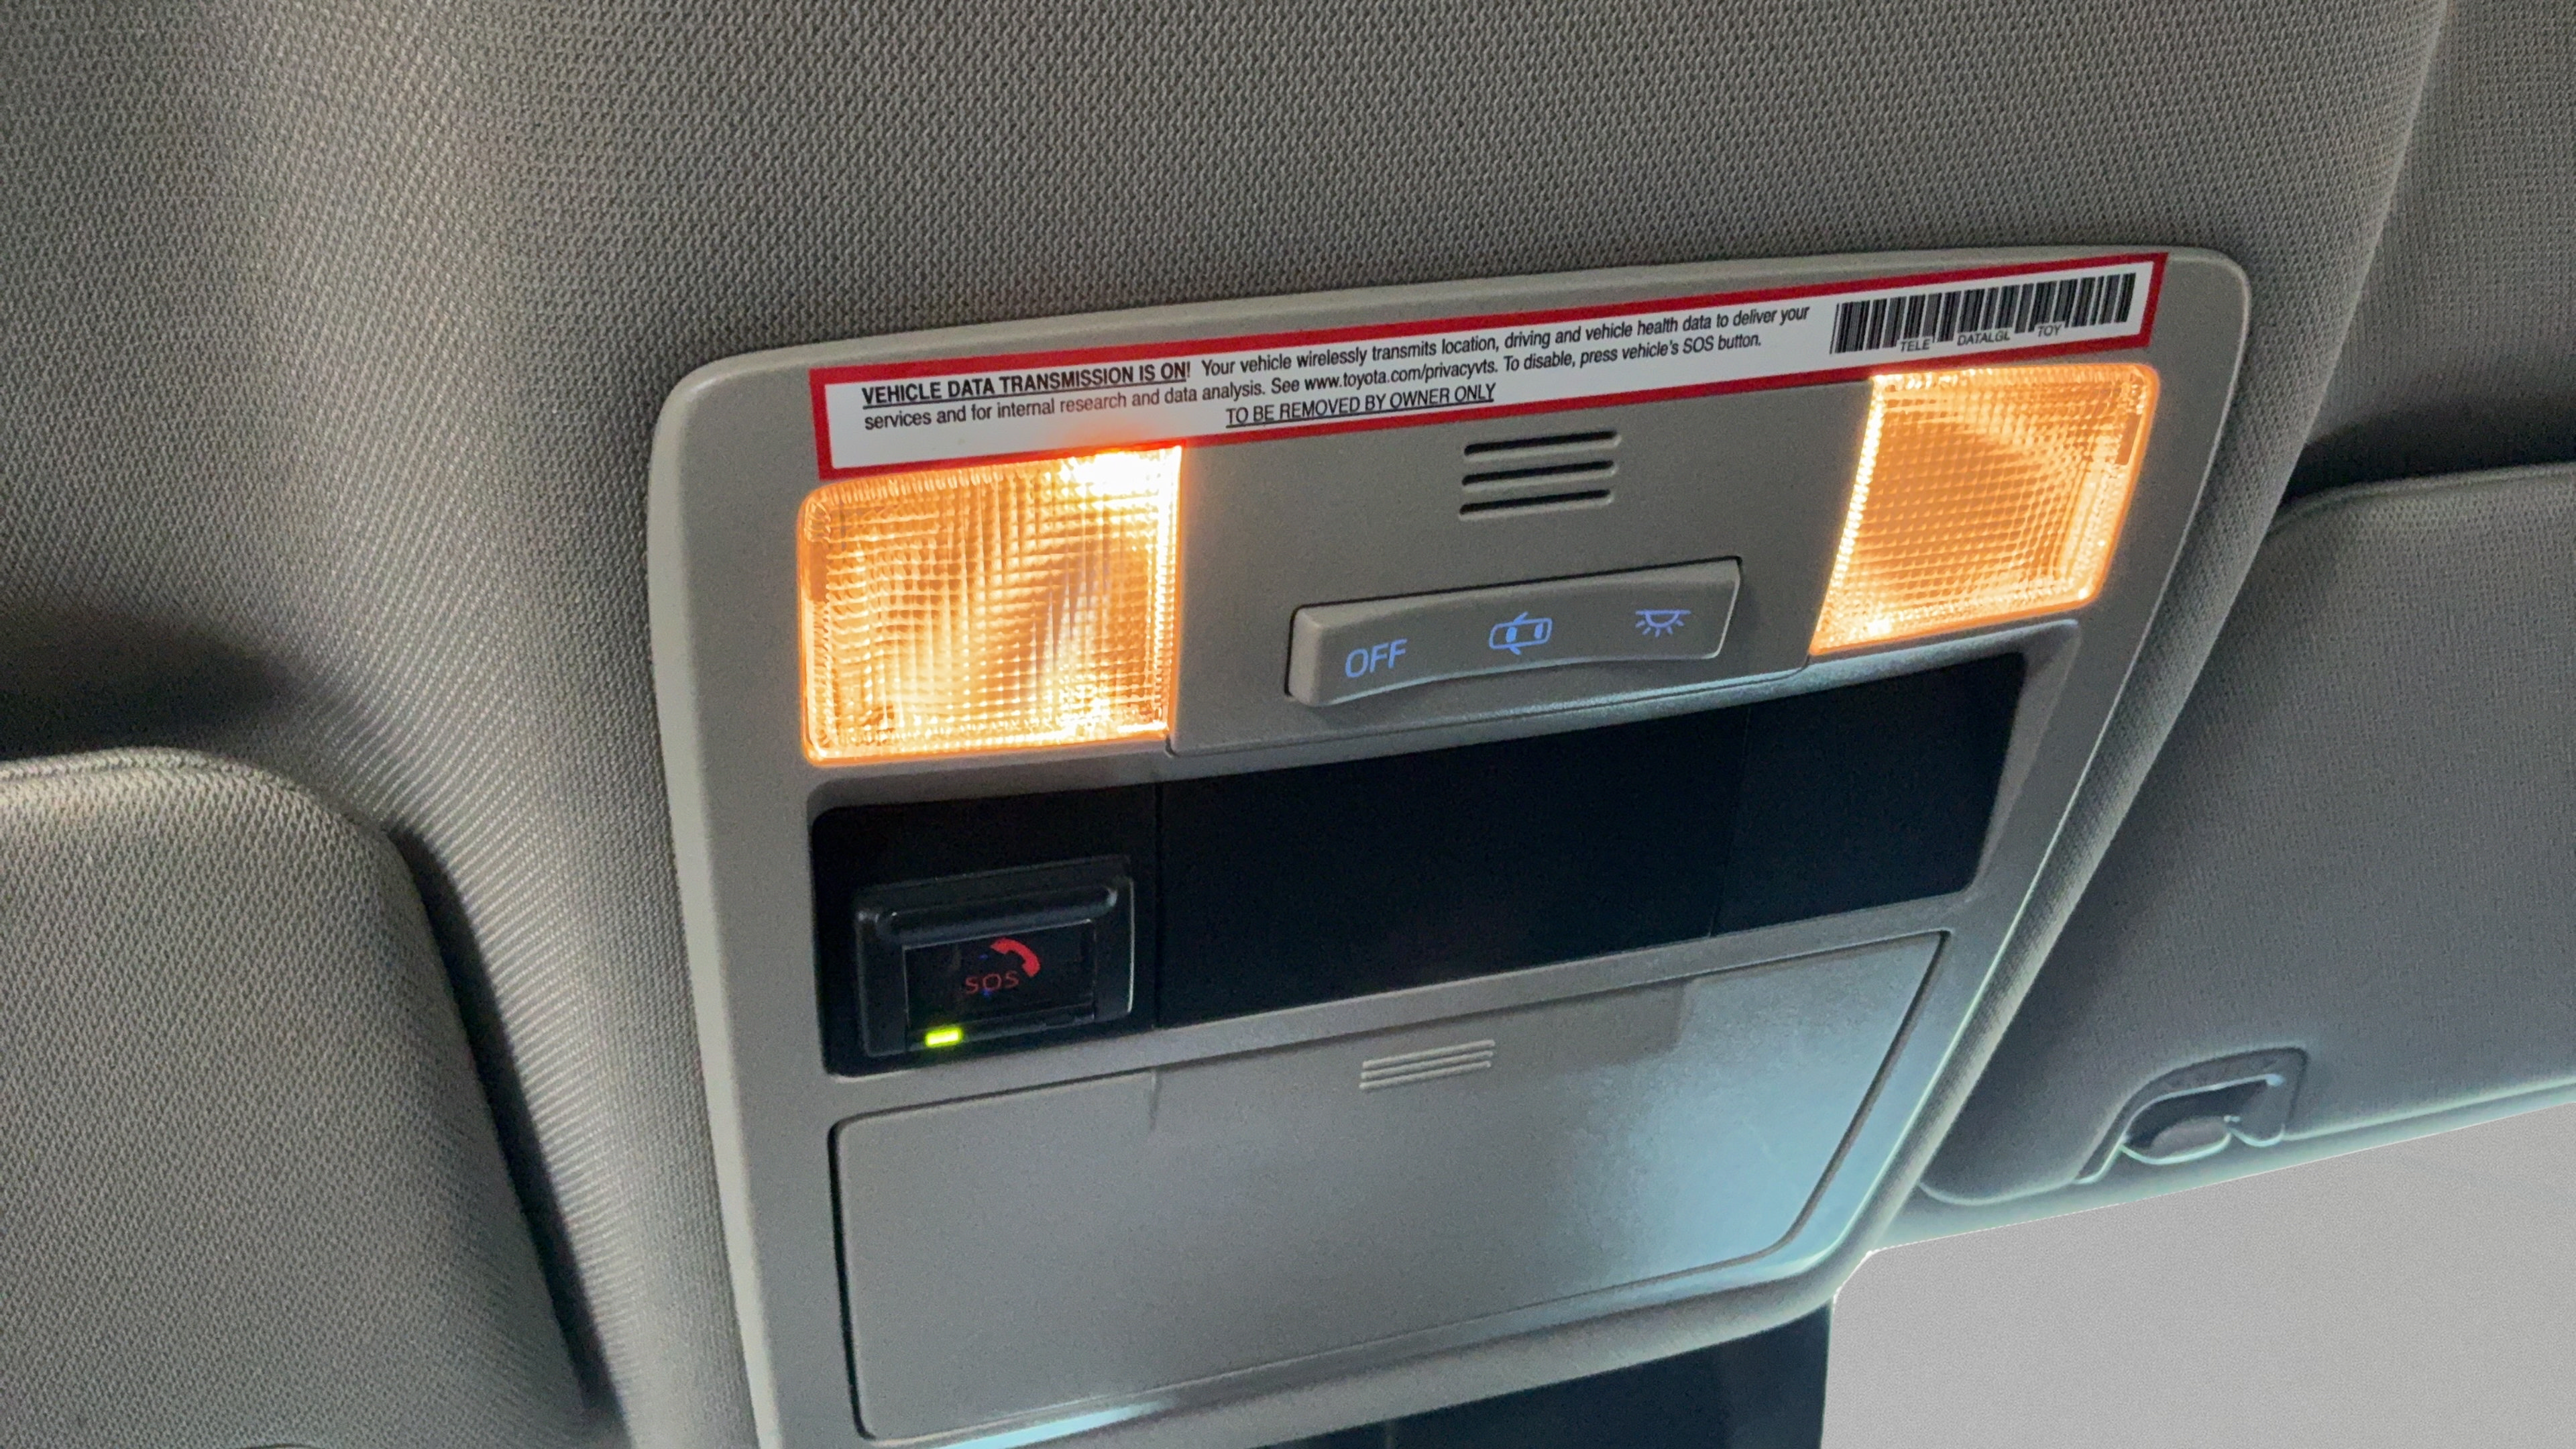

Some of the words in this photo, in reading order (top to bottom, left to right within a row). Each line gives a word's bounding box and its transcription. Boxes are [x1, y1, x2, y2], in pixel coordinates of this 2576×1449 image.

[862, 381, 941, 405] VEHICLE
[948, 378, 995, 397] DATA
[999, 365, 1133, 394] TRANSMISSION
[1139, 364, 1156, 381] IS
[1161, 361, 1190, 380] ON!
[1202, 358, 1233, 376] Your
[1240, 352, 1291, 372] vehicle
[1296, 347, 1367, 368] wirelessly
[1372, 343, 1437, 362] transmits
[1441, 336, 1499, 355] location,
[1504, 330, 1551, 349] driving
[1555, 325, 1580, 343] and
[1585, 319, 1632, 339] vehicle
[1637, 315, 1678, 336] health
[1683, 313, 1712, 331] data
[1716, 312, 1728, 327] to
[1732, 307, 1777, 326] deliver
[1780, 306, 1809, 325] your
[1900, 339, 1929, 352] TELE
[2038, 323, 2062, 337] TOY
[864, 407, 932, 430] services
[936, 405, 964, 423] and
[971, 403, 992, 421] for
[997, 398, 1055, 418] internal
[1060, 392, 1127, 413] research
[1131, 390, 1160, 407] and
[1165, 386, 1197, 403] data
[1202, 380, 1265, 402] analysis.
[1271, 376, 1300, 394] See
[1304, 358, 1498, 390] www.toyota.com/privacyvts.
[1503, 356, 1519, 372] To
[1524, 350, 1575, 371] disable,
[1580, 348, 1618, 368] press
[1622, 339, 1679, 360] vehicle's
[1682, 335, 1714, 354] SOS
[1718, 333, 1761, 350] button.
[1226, 407, 1248, 425] TO
[1253, 405, 1274, 423] BE
[1279, 396, 1360, 420] REMOVED
[1365, 394, 1386, 411] BY
[1389, 387, 1449, 409] OWNER
[1454, 383, 1496, 403] ONLY
[1345, 639, 1407, 679] OFF
[964, 971, 1020, 995] SOS
